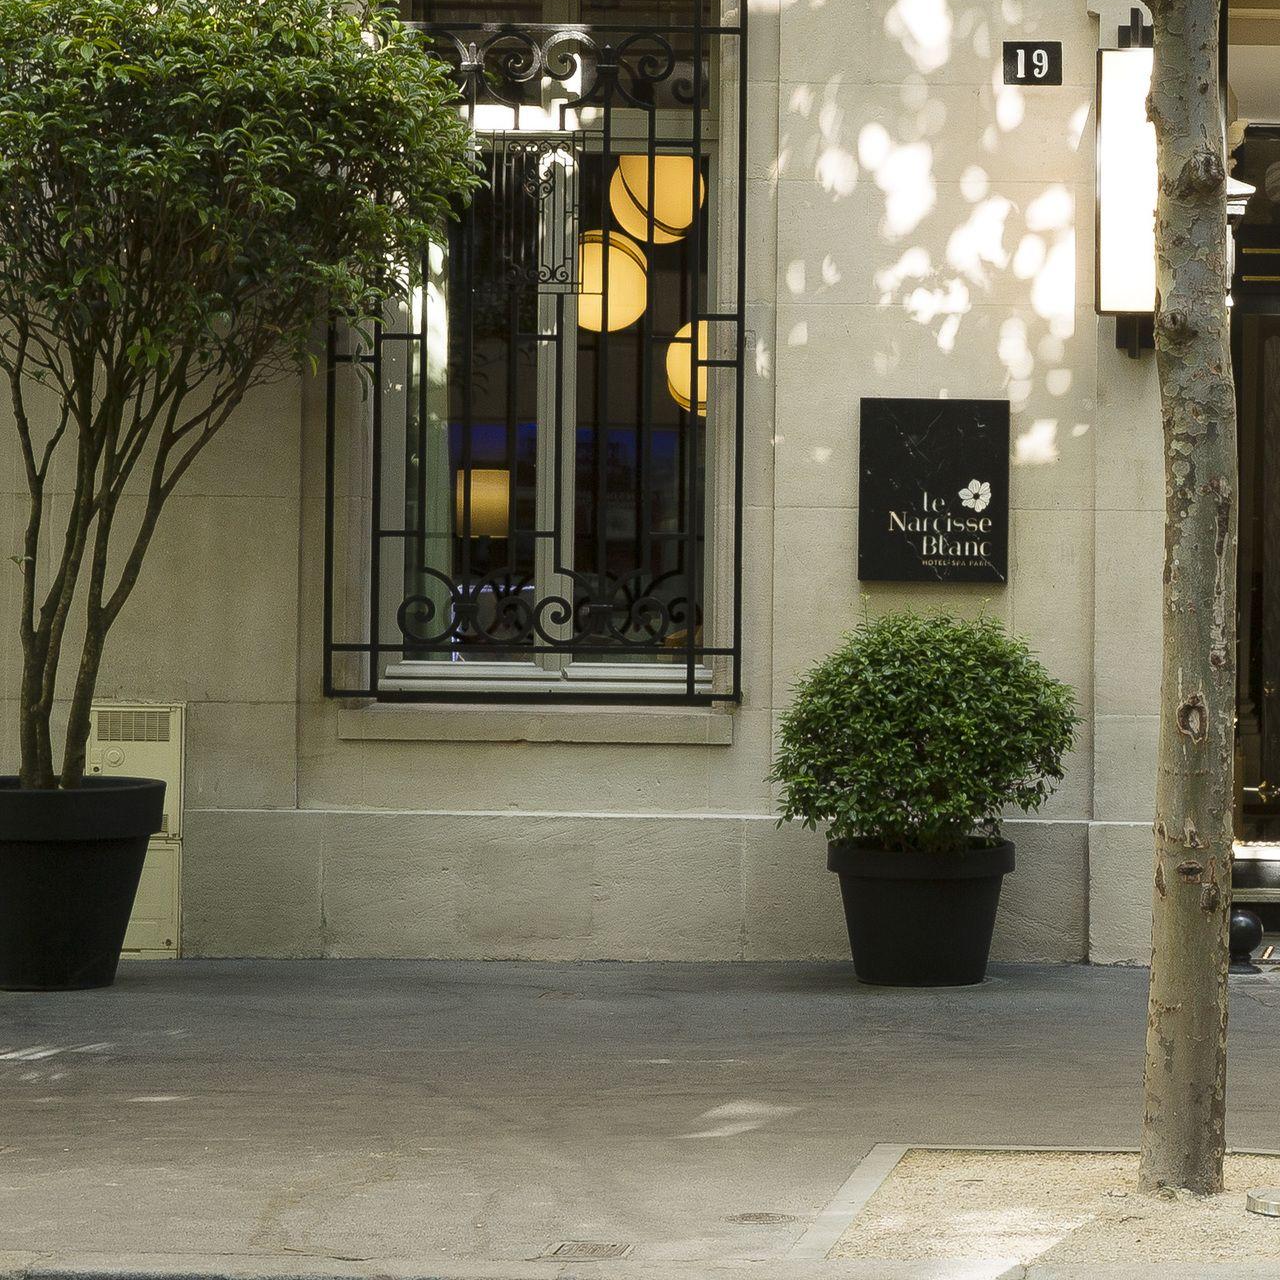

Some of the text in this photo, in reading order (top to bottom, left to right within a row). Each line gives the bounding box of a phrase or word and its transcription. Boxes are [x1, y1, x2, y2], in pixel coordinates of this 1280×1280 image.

[1016, 49, 1049, 79] 19
[888, 511, 992, 533] Narcisse
[922, 535, 992, 556] Blanc
